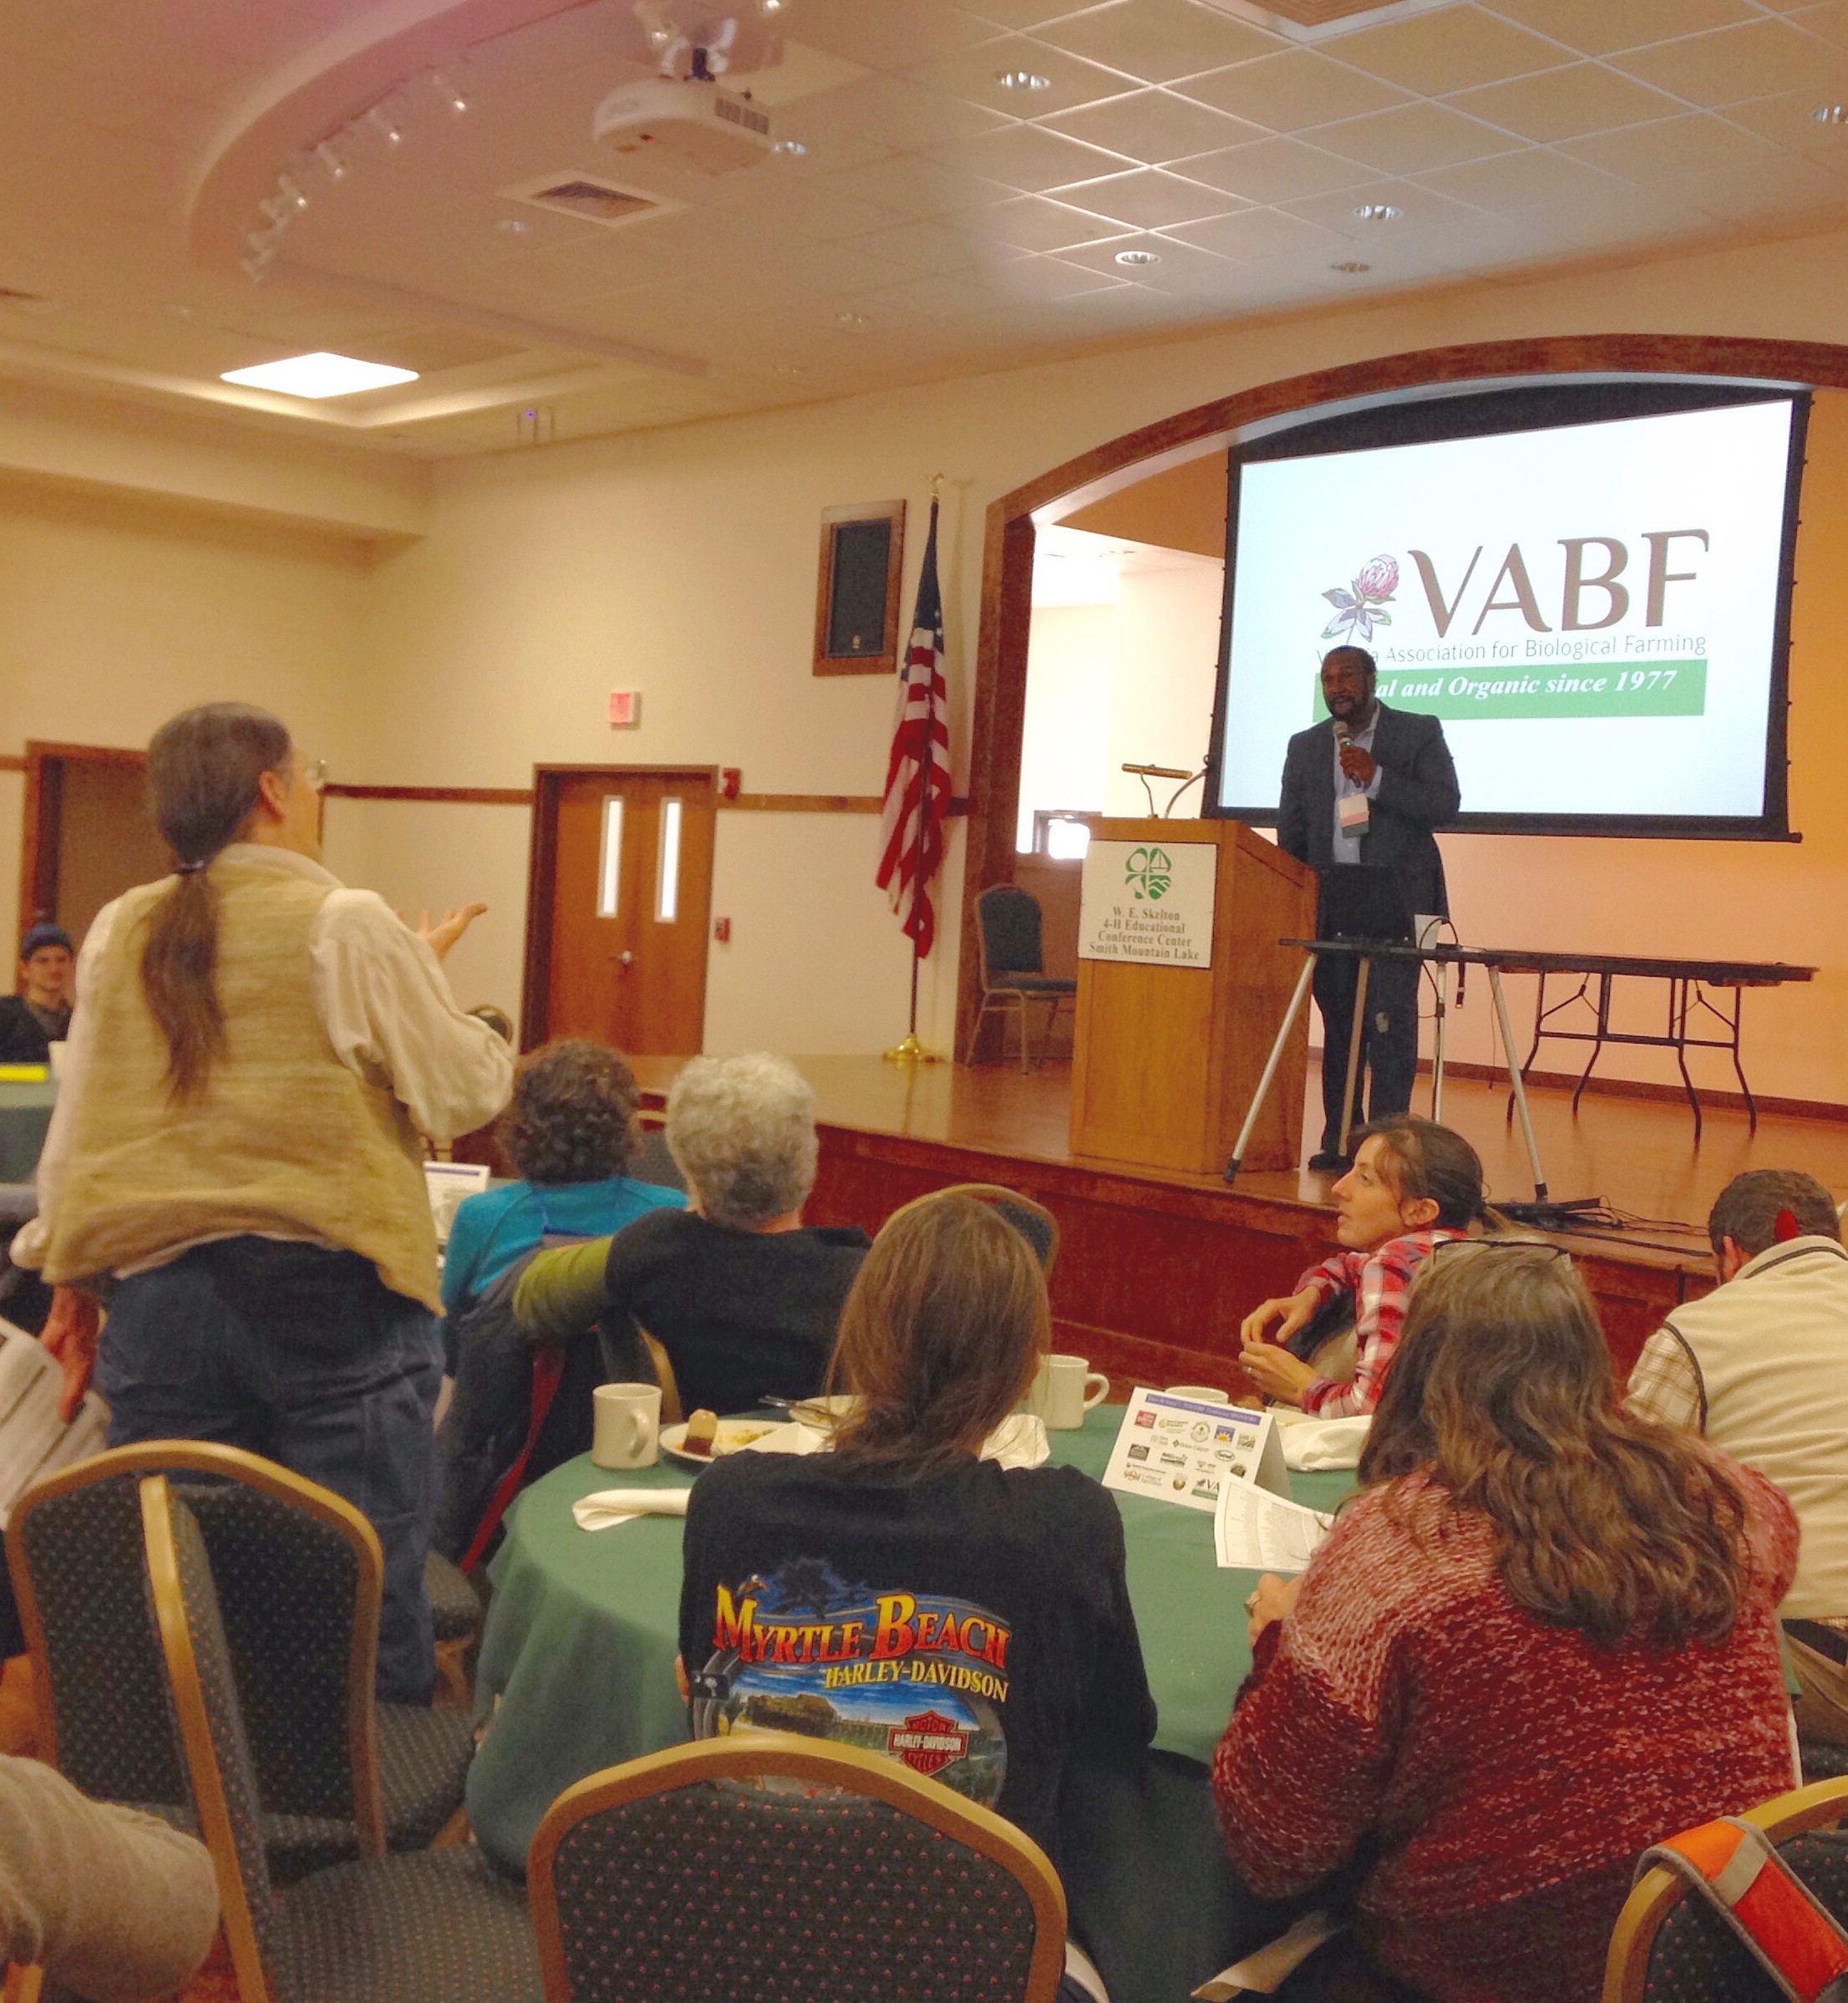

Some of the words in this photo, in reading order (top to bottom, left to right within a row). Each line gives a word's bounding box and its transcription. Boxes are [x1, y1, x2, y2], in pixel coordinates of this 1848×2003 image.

[1407, 528, 1709, 638] VABF
[1385, 643, 1485, 663] Association
[1492, 641, 1518, 658] for
[1526, 636, 1616, 660] Biological
[1624, 634, 1706, 656] Farming
[1401, 678, 1444, 697] and
[1448, 674, 1541, 700] Organic
[1545, 674, 1607, 694] since
[1615, 670, 1678, 691] 1977
[1113, 906, 1124, 918] W.
[1129, 907, 1139, 918] E.
[1142, 907, 1180, 921] Skelton
[1104, 918, 1121, 930] 4-H
[1125, 921, 1185, 934] Educational
[1098, 930, 1154, 944] Conference
[1157, 934, 1192, 947] Center
[1089, 942, 1118, 954] Smith
[1122, 944, 1170, 958] Mountain
[1174, 948, 1200, 960] Lake
[1207, 1478, 1220, 1492] VA
[825, 1660, 1009, 1704] HARLEY-DAVIDSON
[893, 1733, 962, 1751] HARLEY-DAVIDSON
